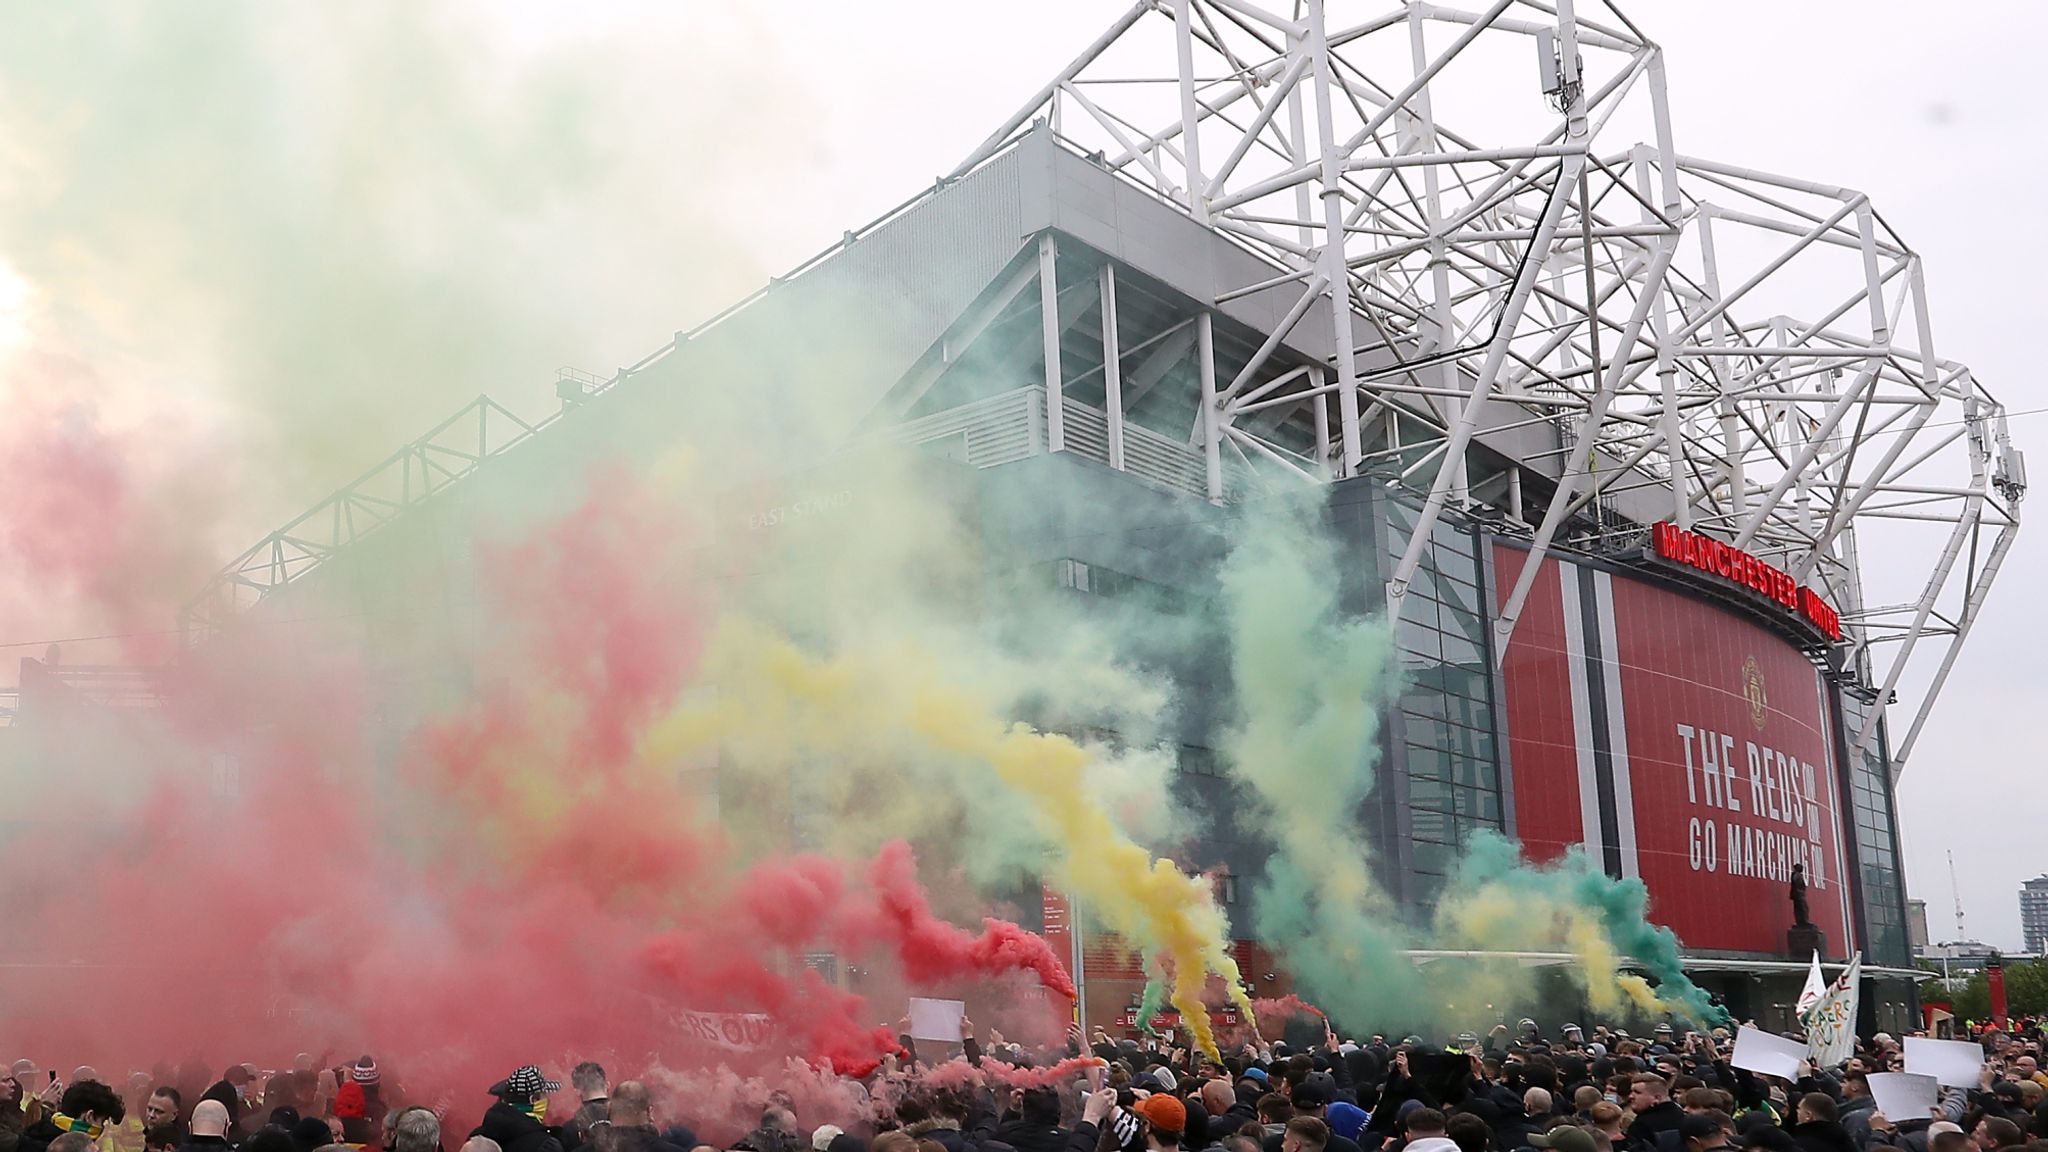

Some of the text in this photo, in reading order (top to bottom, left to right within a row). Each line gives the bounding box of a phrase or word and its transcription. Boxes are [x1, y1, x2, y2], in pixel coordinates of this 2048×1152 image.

[749, 489, 854, 529] EAST STAND
[1656, 522, 1797, 609] MANCHESTER
[1676, 723, 1741, 812] THE
[1746, 741, 1804, 828] REDS
[1689, 817, 1718, 873] GO
[1727, 823, 1810, 887] MARCHING
